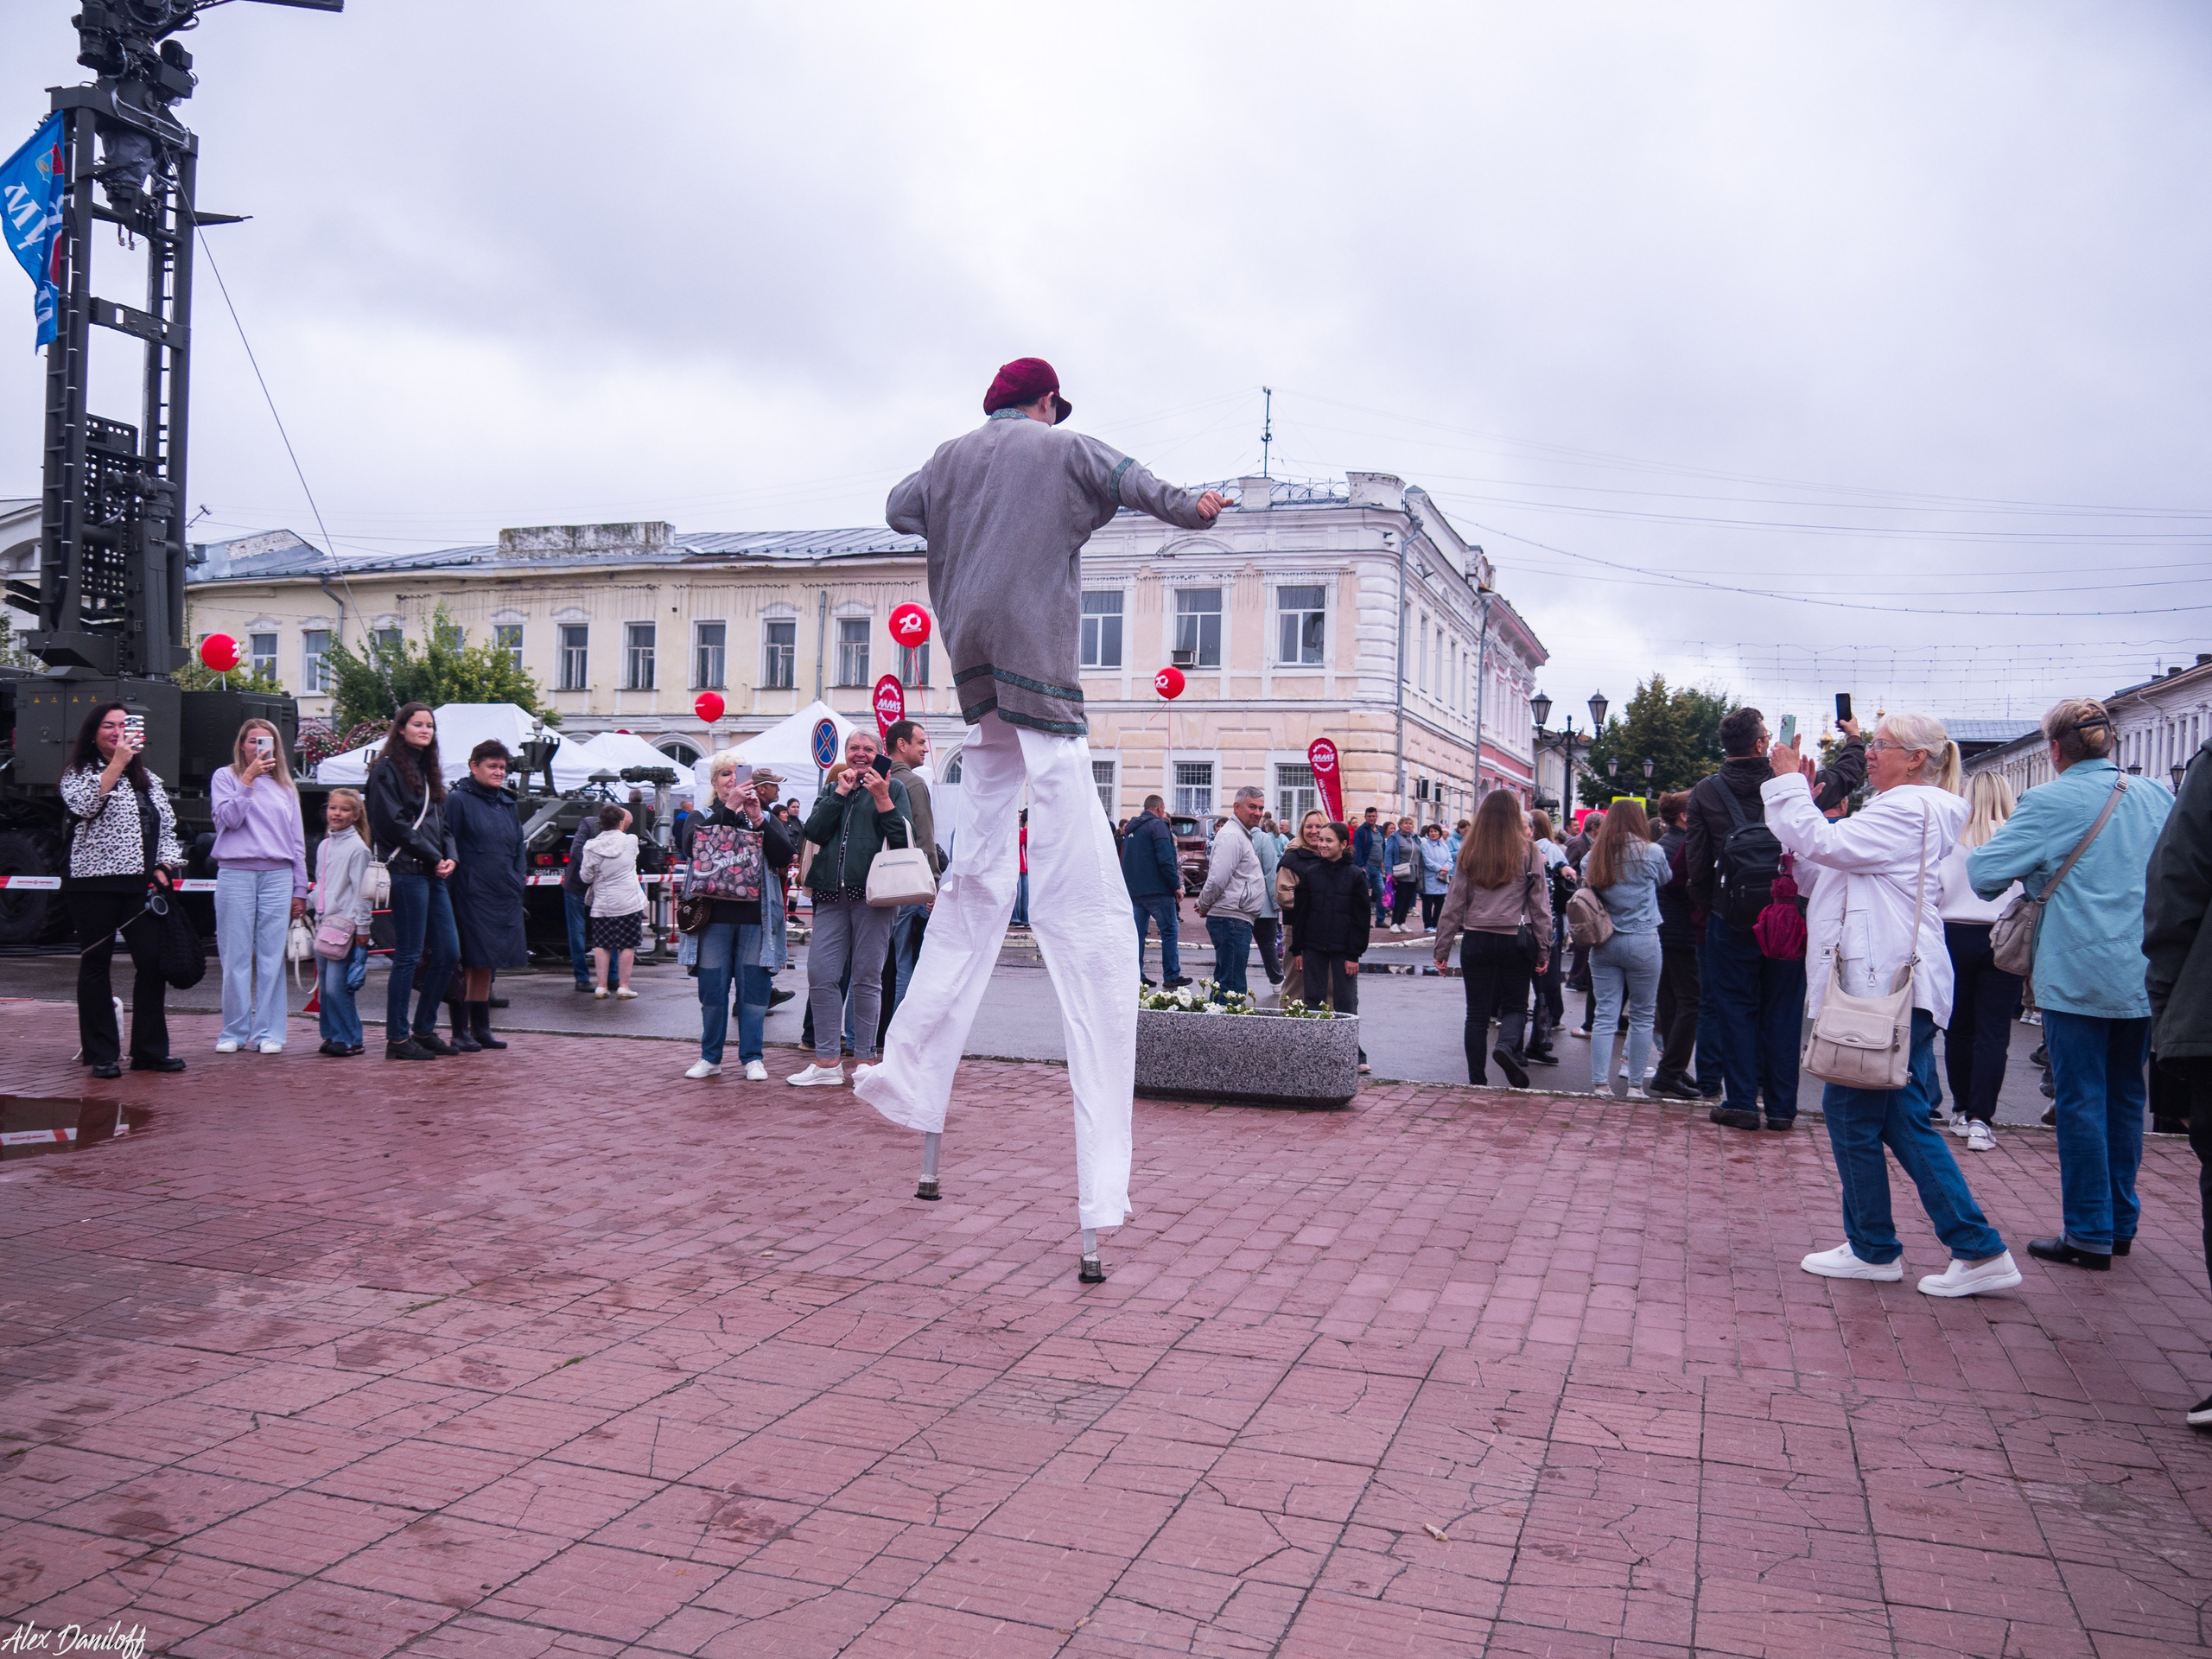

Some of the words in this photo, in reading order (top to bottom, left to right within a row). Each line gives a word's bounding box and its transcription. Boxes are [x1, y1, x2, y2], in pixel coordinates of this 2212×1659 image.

[899, 613, 922, 633] 20
[876, 698, 901, 713] ММЗ
[1311, 753, 1335, 762] ММЗ
[694, 847, 750, 876] Sweet
